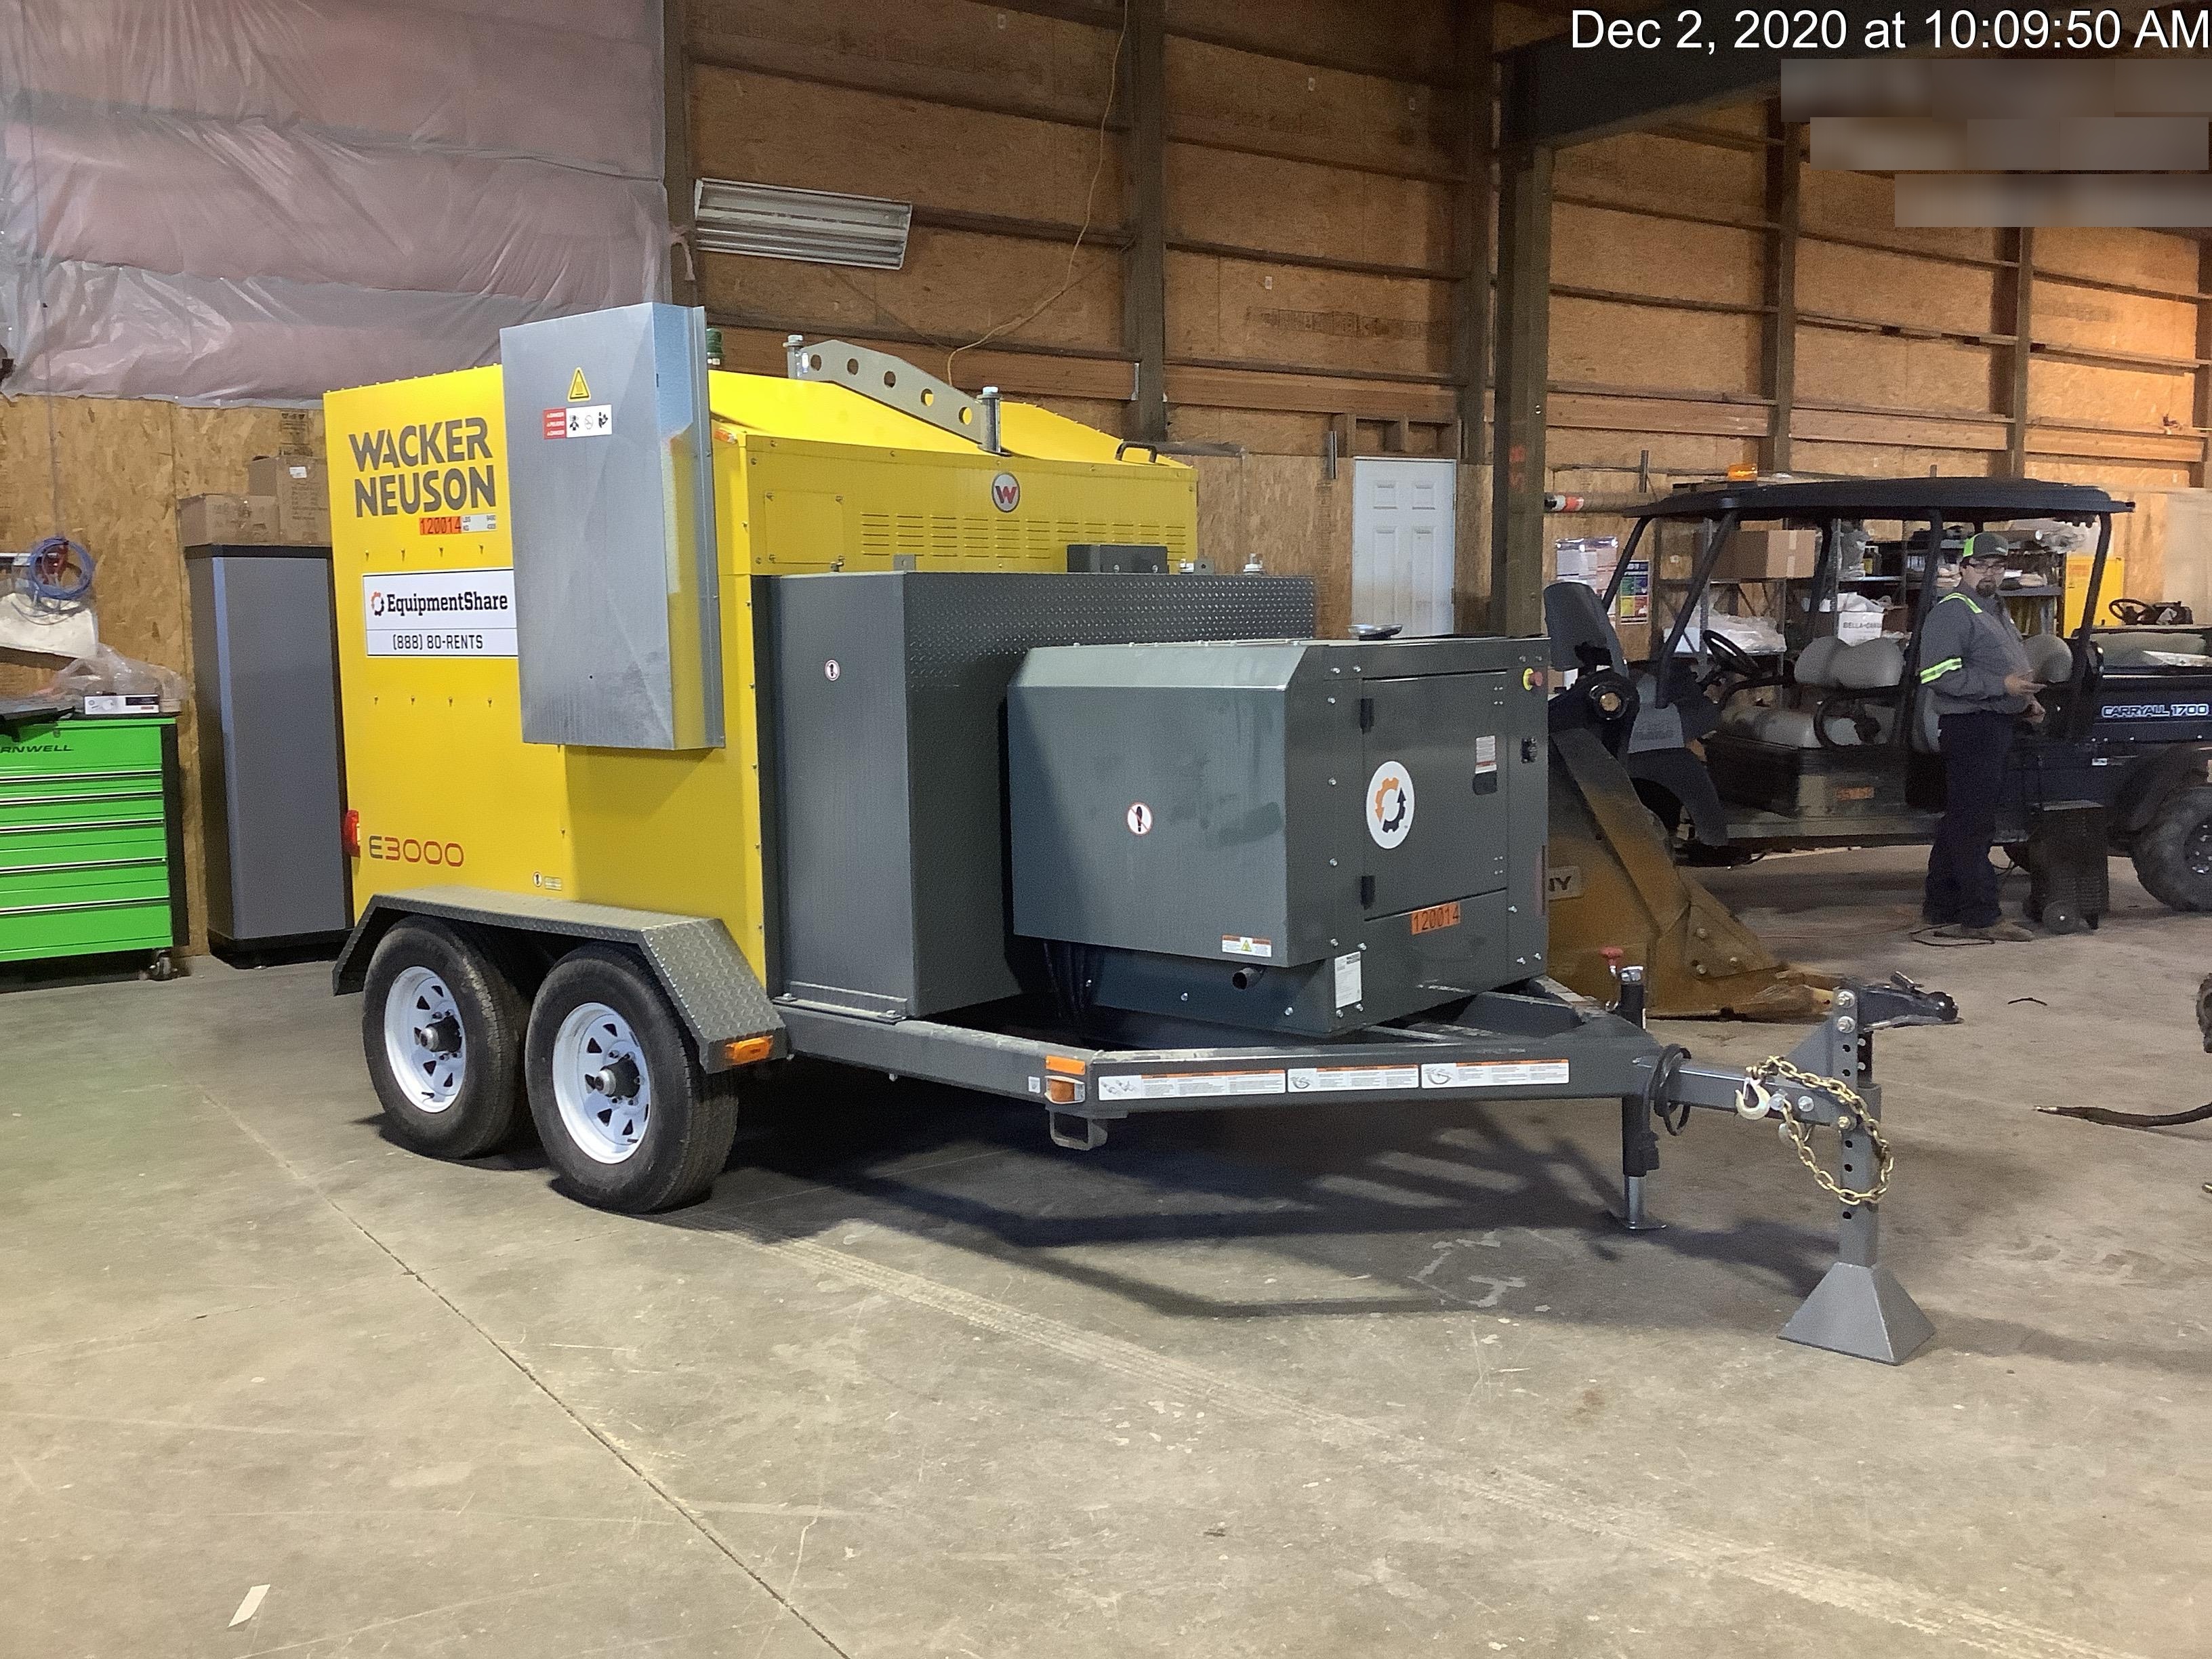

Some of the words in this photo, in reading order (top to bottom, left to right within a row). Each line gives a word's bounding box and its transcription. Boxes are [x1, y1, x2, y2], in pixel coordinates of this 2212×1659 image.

[348, 417, 493, 472] WACKER
[354, 465, 497, 518] NEUSON
[996, 485, 1019, 504] W
[419, 516, 461, 535] 120014
[387, 591, 509, 617] EquipmentShare
[393, 634, 424, 651] (888)
[427, 634, 483, 650] 80-RENTS
[2102, 704, 2169, 718] CARRYALL
[2171, 703, 2209, 717] 1700
[369, 835, 465, 867] E3000
[1414, 904, 1460, 933] 120014
